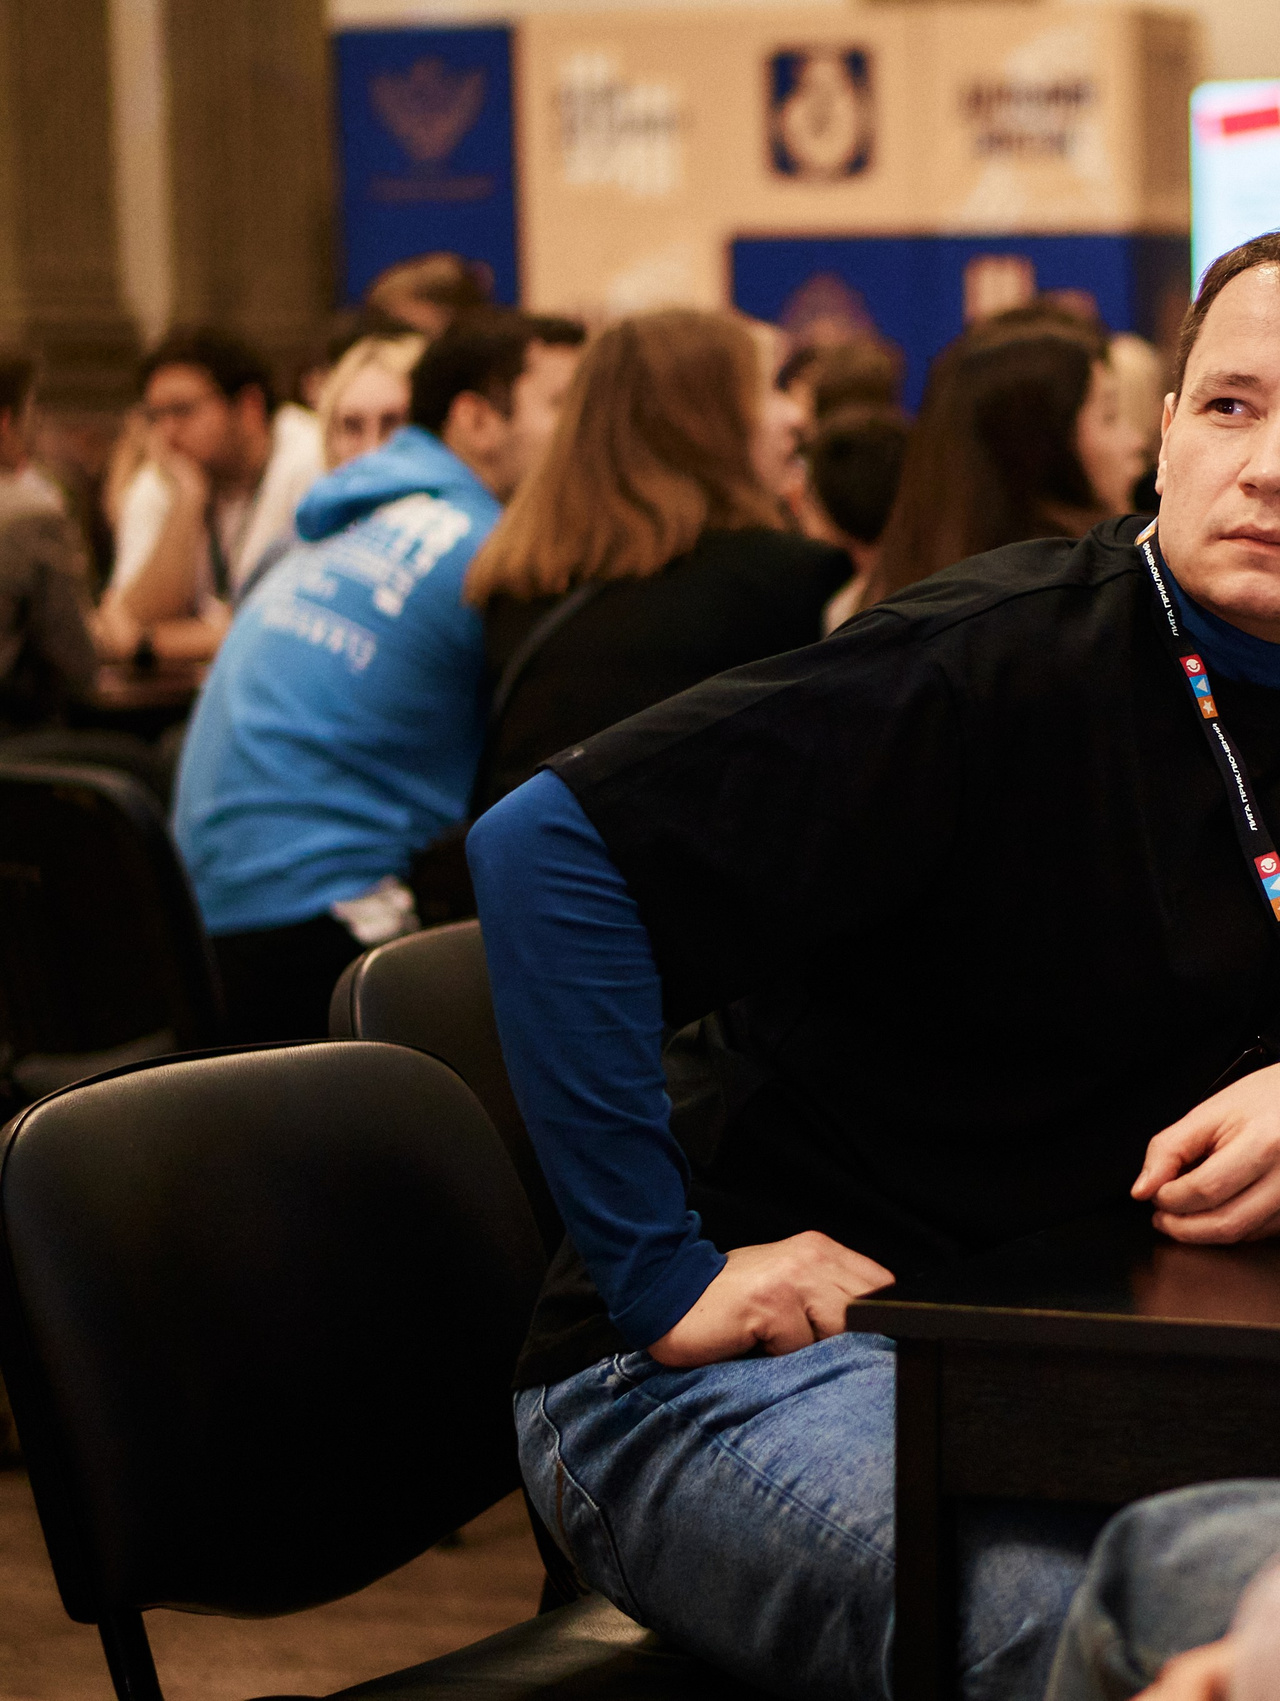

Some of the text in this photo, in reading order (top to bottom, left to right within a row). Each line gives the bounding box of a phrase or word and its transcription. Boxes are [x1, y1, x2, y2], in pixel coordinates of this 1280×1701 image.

[1166, 609, 1180, 637] ЛИГА
[1212, 722, 1258, 831] ЛИГА ПРИКЛЮЧЕНИЙ
